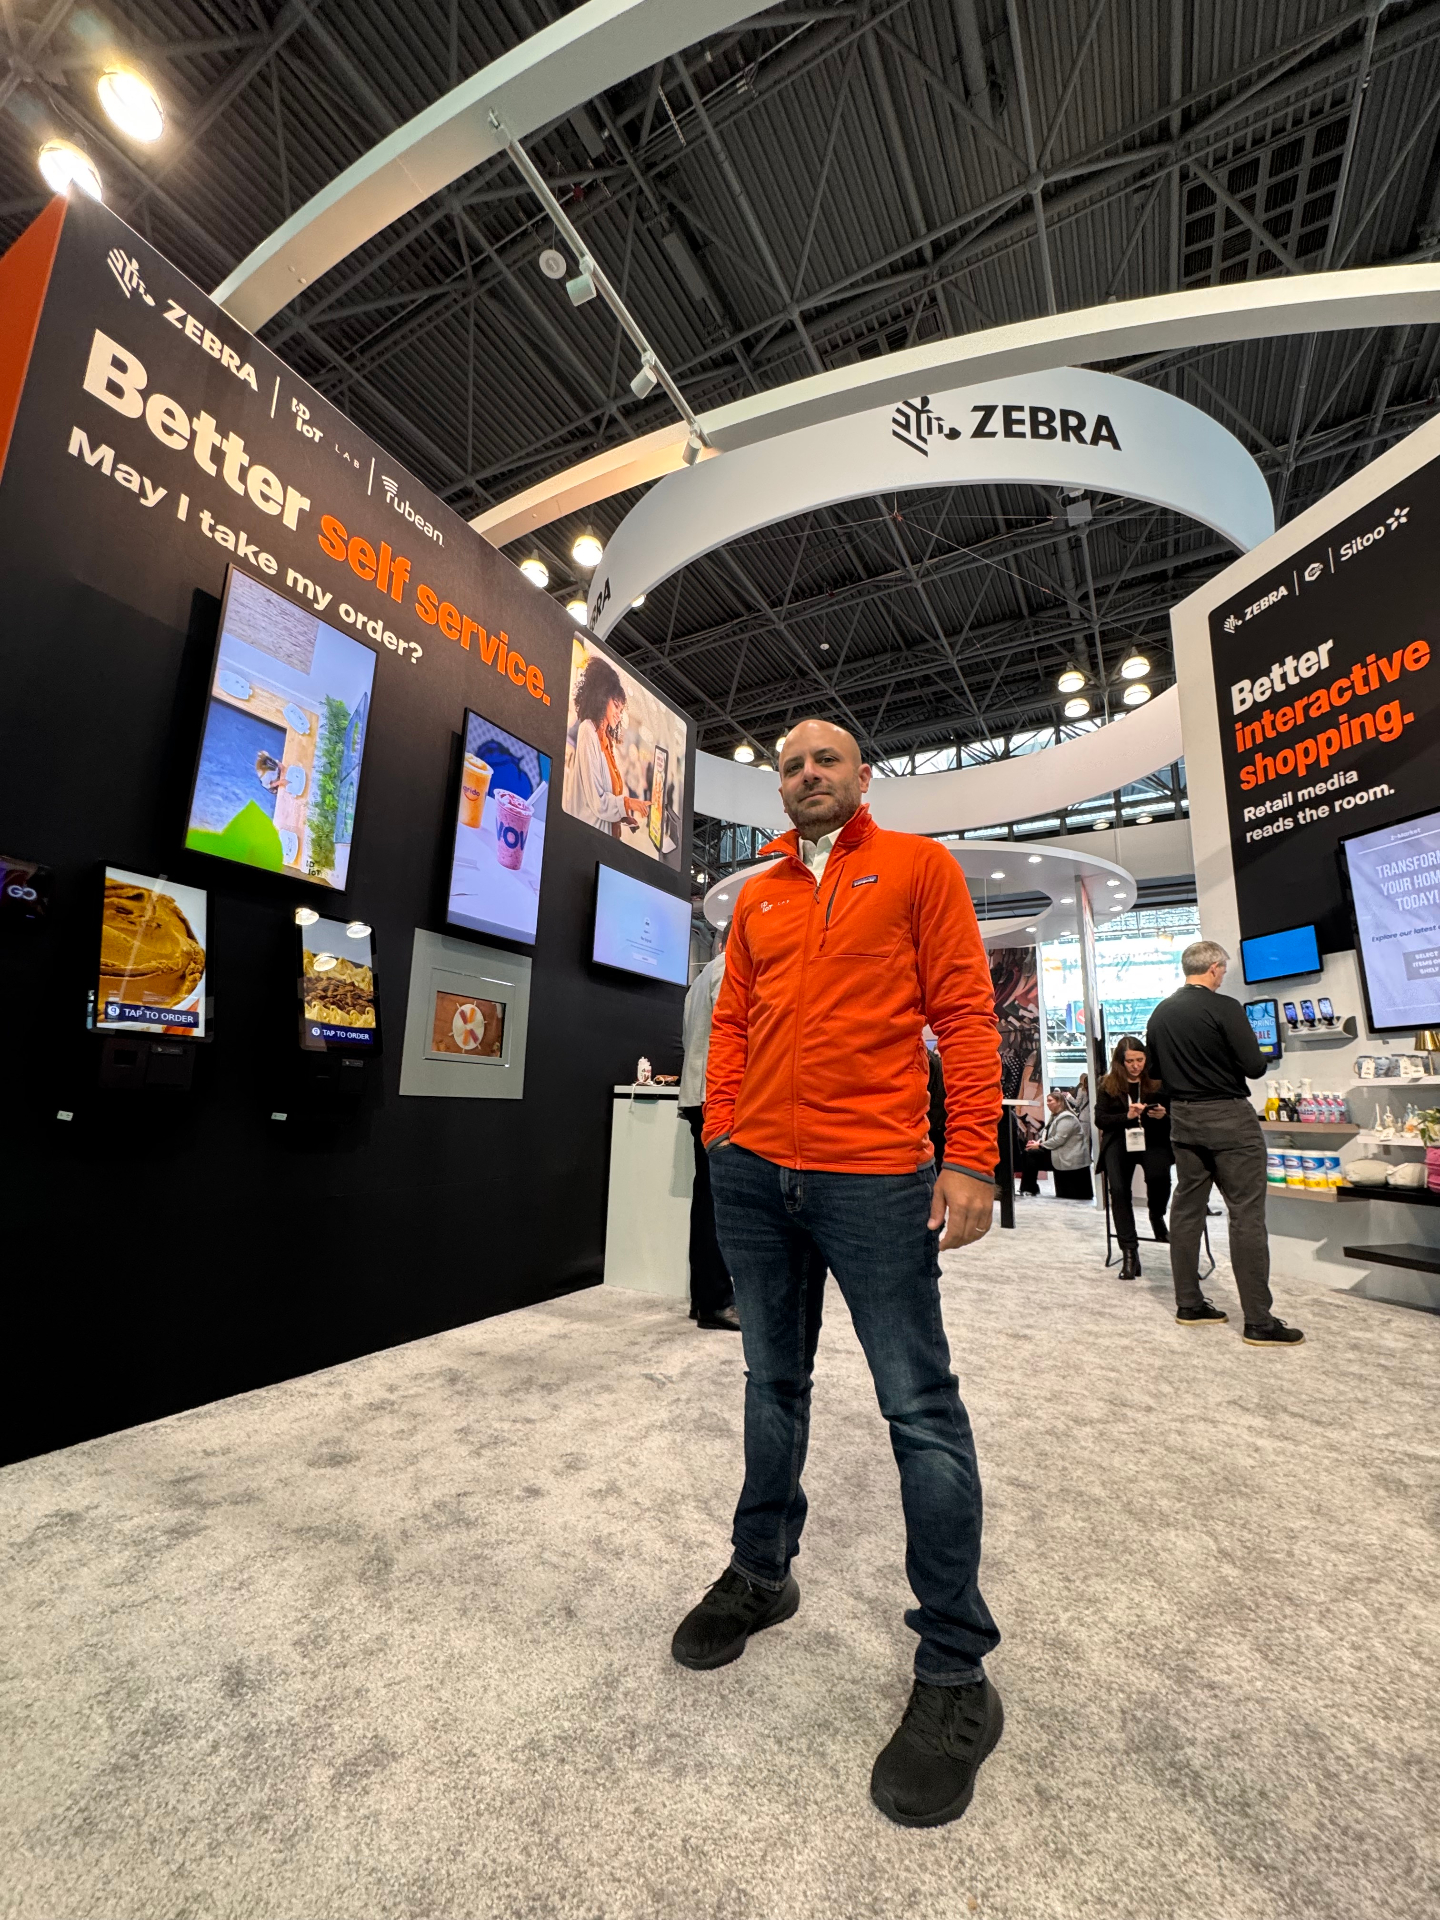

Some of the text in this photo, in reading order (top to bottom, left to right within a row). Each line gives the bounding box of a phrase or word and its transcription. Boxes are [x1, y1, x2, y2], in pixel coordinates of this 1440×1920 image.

[162, 299, 258, 392] ZEBRA
[970, 405, 1122, 451] ZEBRA
[335, 443, 360, 469] LAB
[83, 328, 550, 706] Better self service.
[386, 490, 444, 547] rubean
[67, 425, 423, 664] May I take my order?
[1340, 526, 1385, 561] Sitoo
[1244, 585, 1289, 621] ZEBRA
[1230, 638, 1334, 716] Better
[1234, 640, 1431, 753] interactive
[1239, 699, 1415, 791] shopping.
[1243, 768, 1358, 823] Retail media
[1245, 782, 1395, 844] reads the room.
[1380, 877, 1412, 897] YOUR
[1395, 889, 1439, 911] TODAY!
[1372, 924, 1436, 943] Explore our latest
[123, 1008, 142, 1018] TAP
[144, 1010, 158, 1020] TO
[161, 1013, 194, 1023] ORDER
[322, 1029, 335, 1037] TAP
[336, 1030, 346, 1038] TO
[347, 1032, 370, 1040] ORDER
